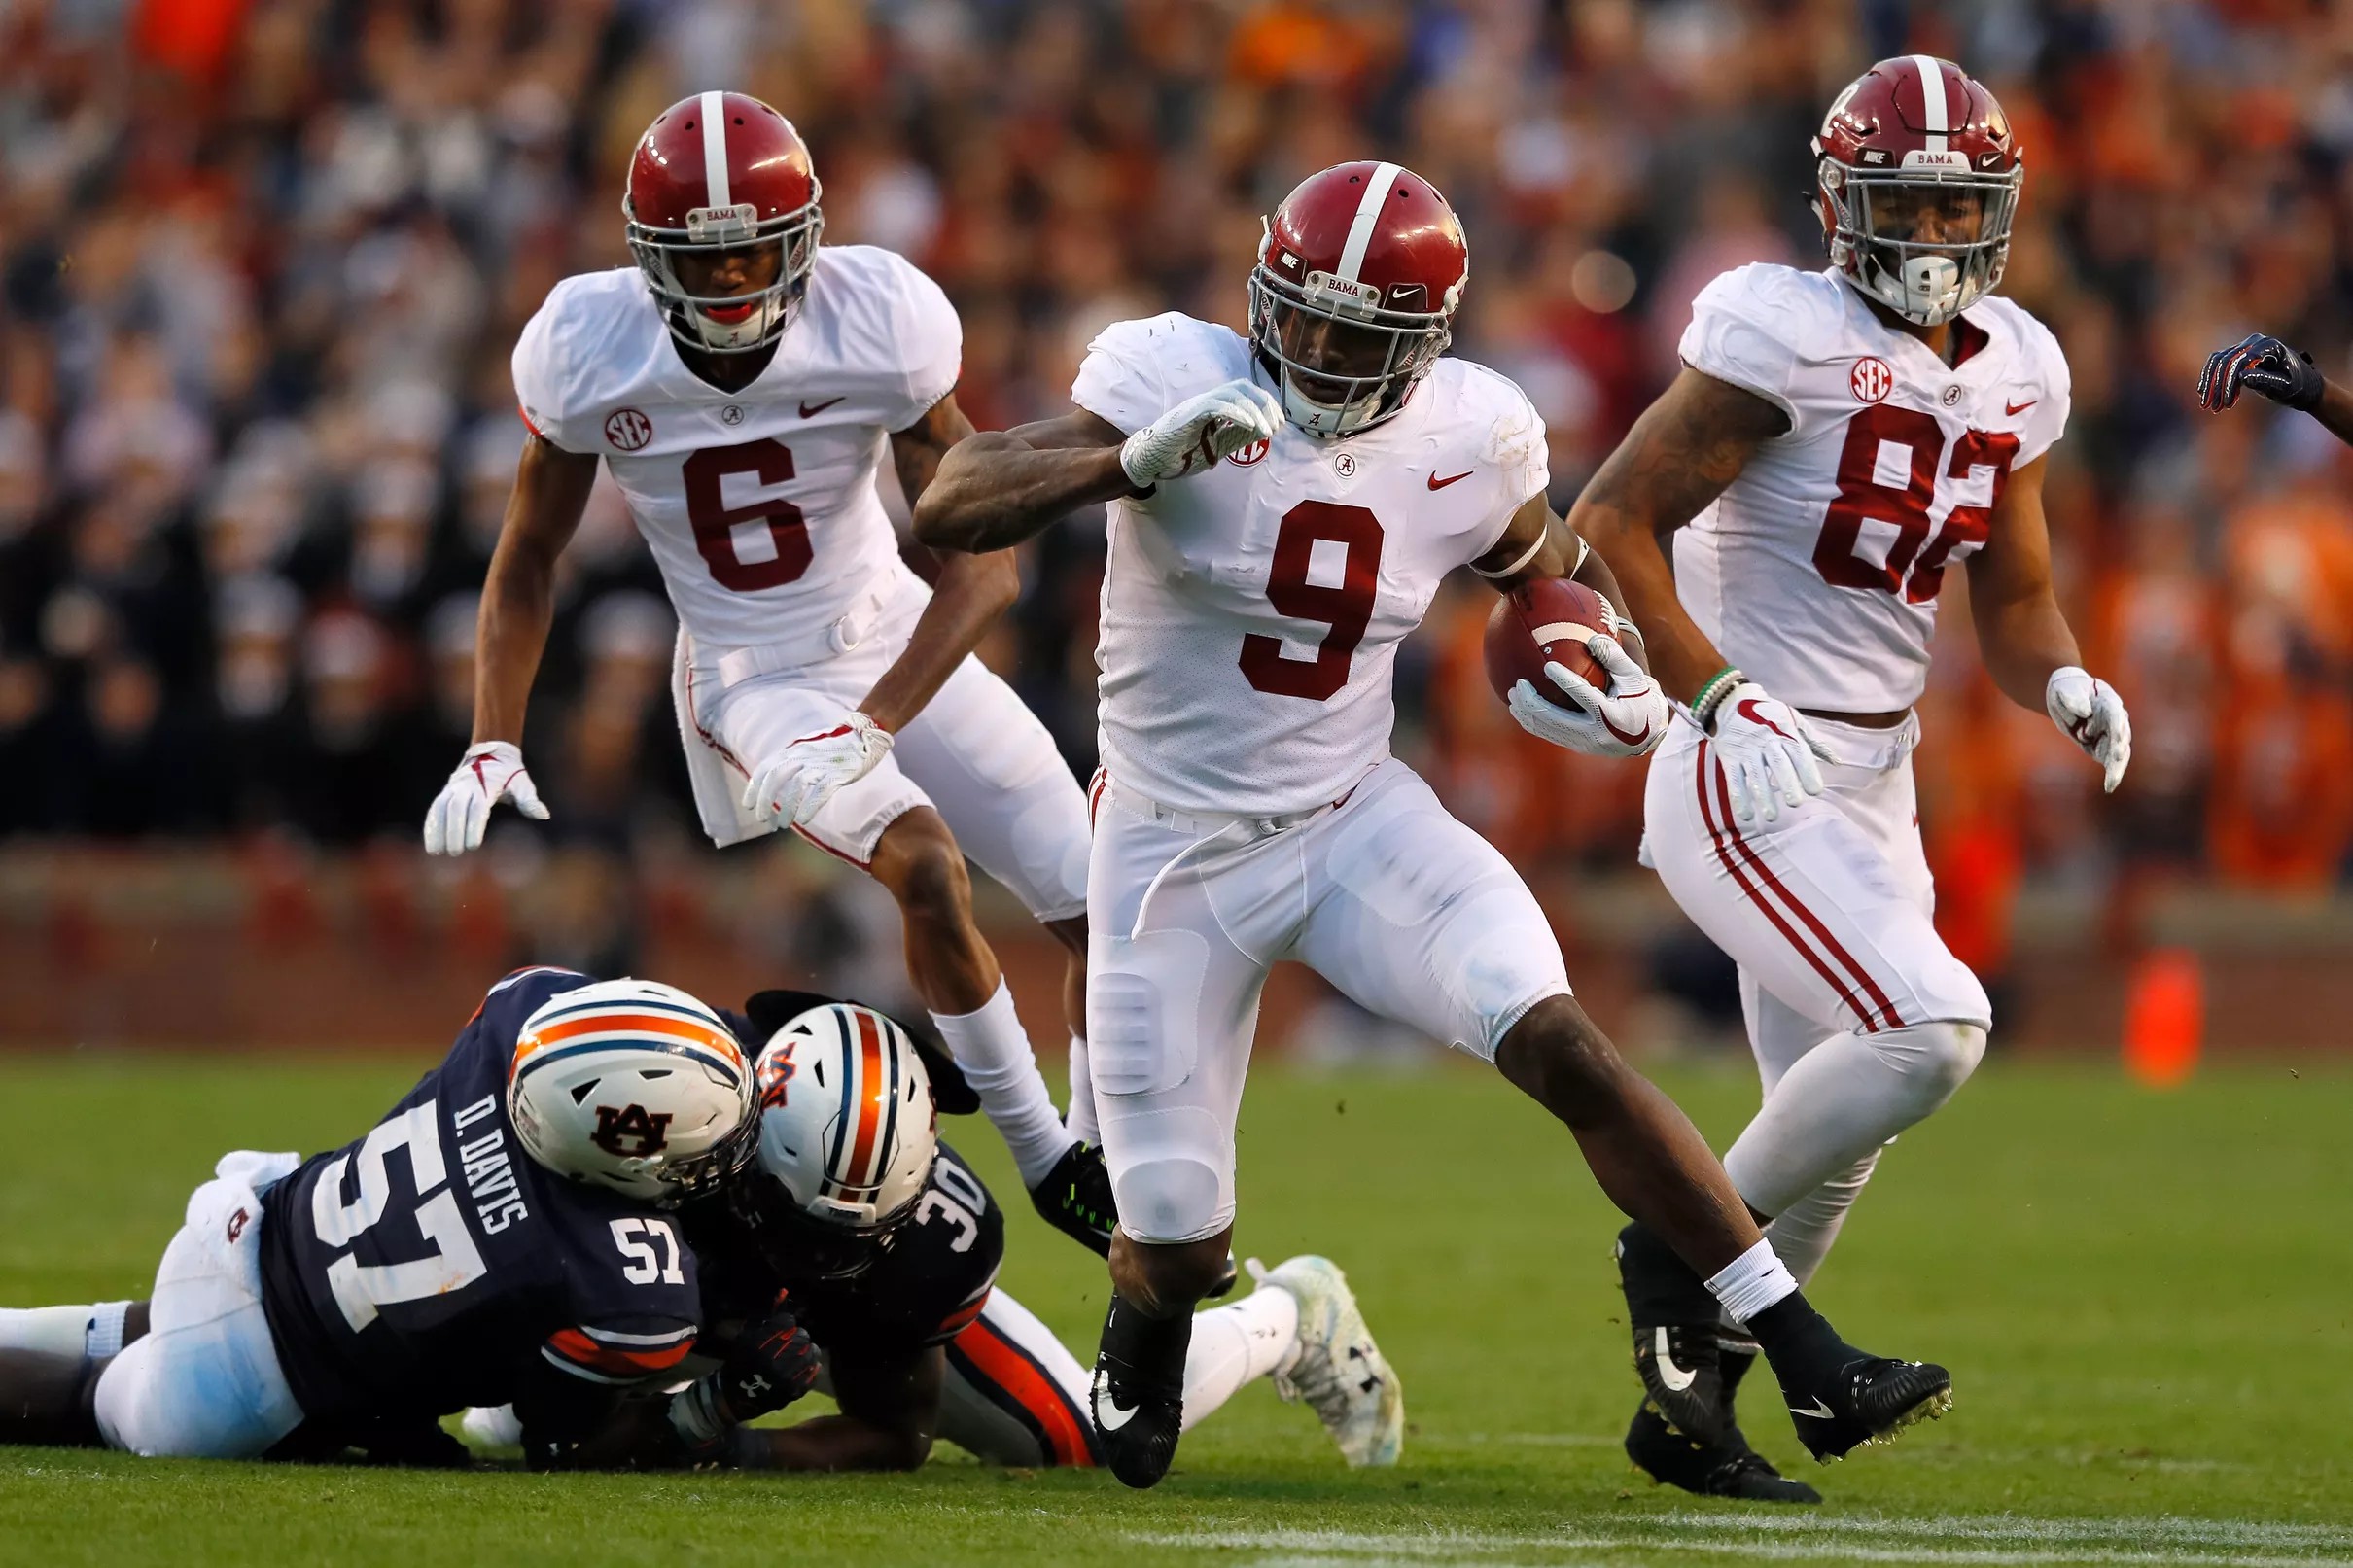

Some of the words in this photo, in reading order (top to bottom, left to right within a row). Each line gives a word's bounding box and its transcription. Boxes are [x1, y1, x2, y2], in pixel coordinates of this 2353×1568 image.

[1863, 150, 1886, 164] NIKE
[1917, 154, 1953, 164] BAMA
[706, 209, 737, 222] BAMA
[1280, 252, 1300, 269] NIKE
[1327, 278, 1359, 296] BAMA
[1851, 358, 1891, 401] SEC
[606, 411, 651, 449] SEC
[683, 437, 814, 592] 6
[1811, 402, 2020, 605] 82
[1238, 499, 1385, 702] 9
[453, 1094, 497, 1138] D.
[460, 1132, 528, 1236] DAVIS
[916, 1157, 987, 1253] 30
[312, 1098, 487, 1334] 57
[609, 1217, 685, 1285] 57
